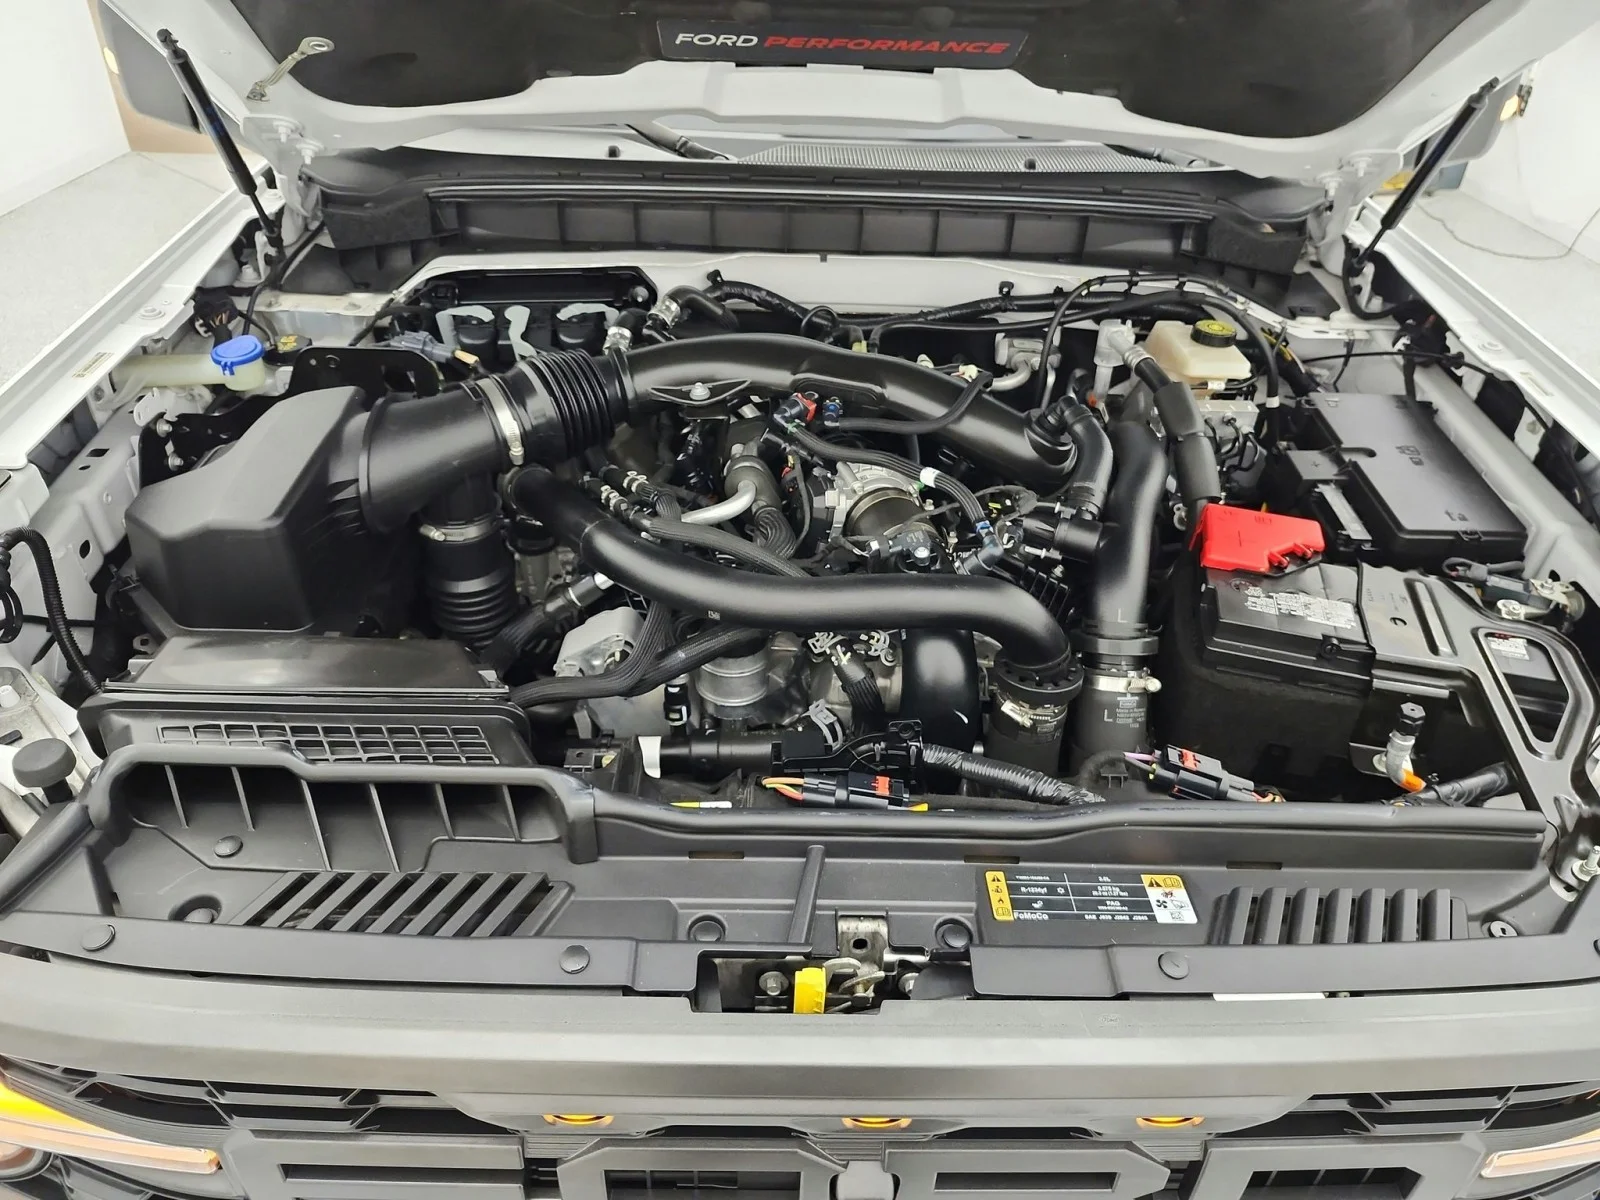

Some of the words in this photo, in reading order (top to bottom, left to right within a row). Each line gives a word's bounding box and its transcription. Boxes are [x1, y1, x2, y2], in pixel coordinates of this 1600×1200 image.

[675, 33, 758, 47] FORD
[764, 36, 1010, 53] PERFORMANCE
[1014, 912, 1049, 920] FoMoCo
